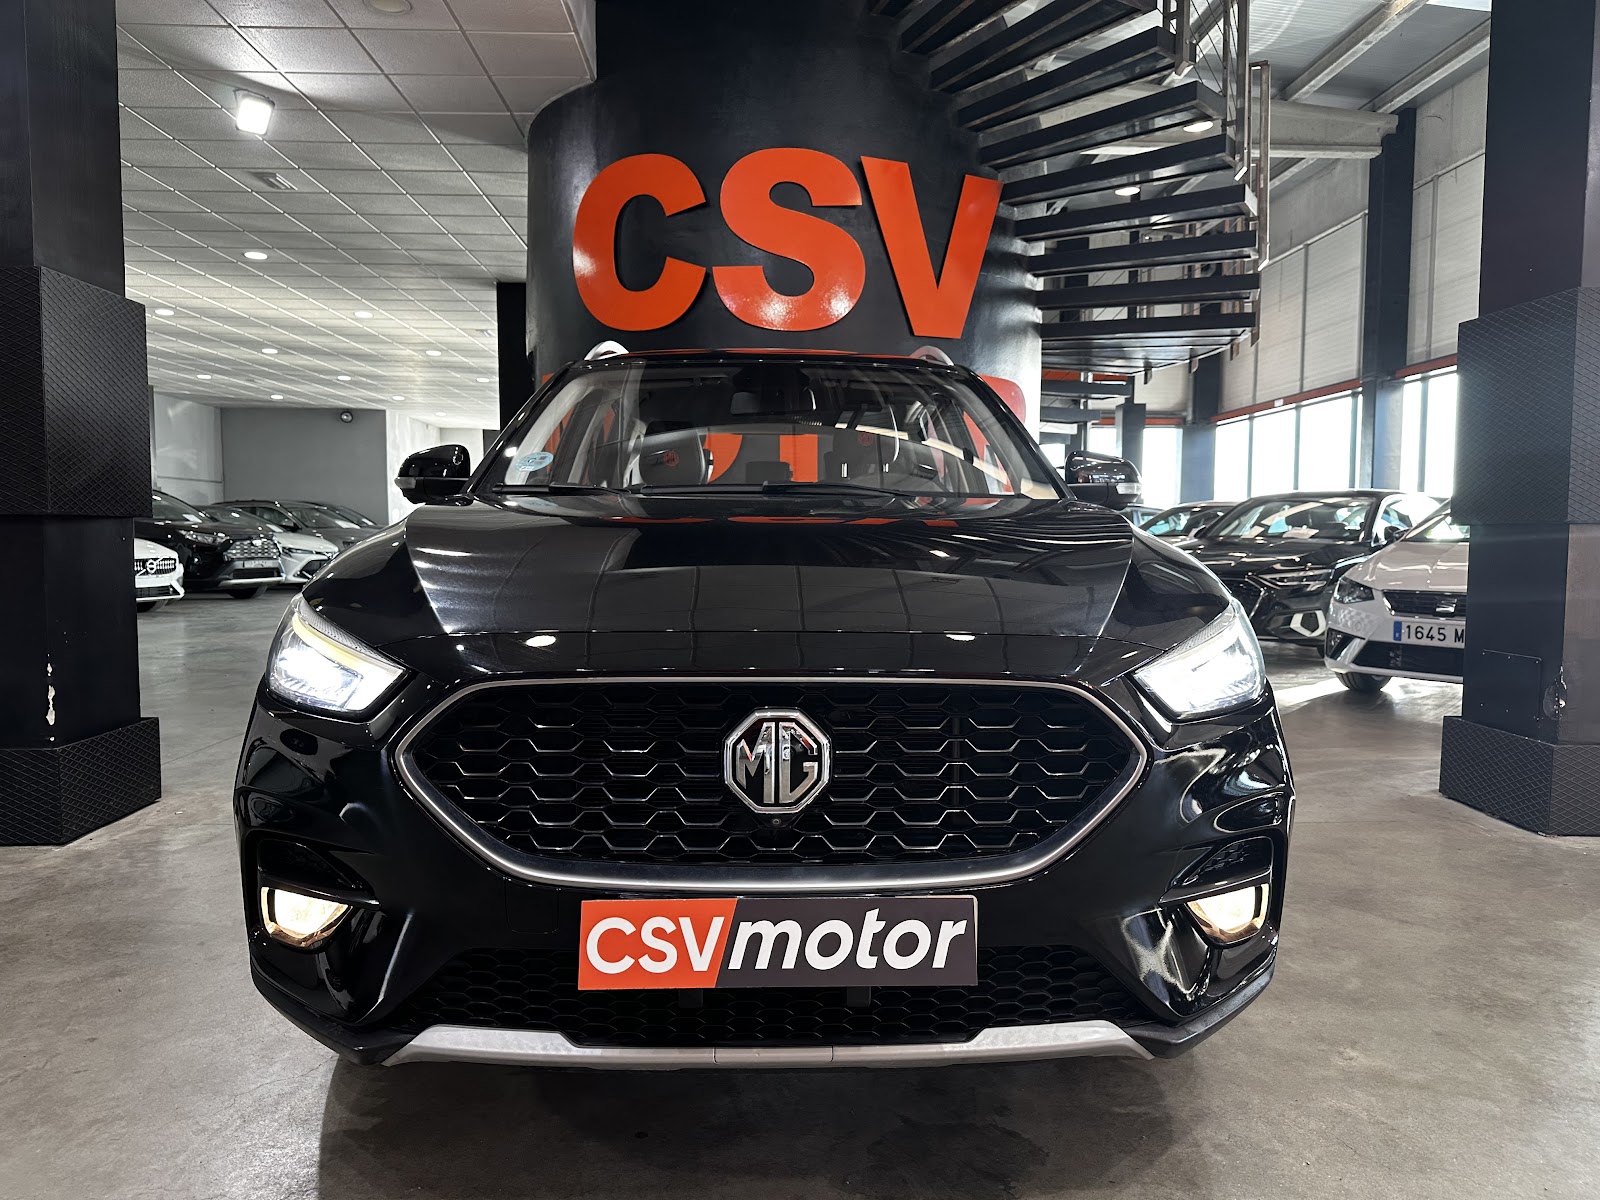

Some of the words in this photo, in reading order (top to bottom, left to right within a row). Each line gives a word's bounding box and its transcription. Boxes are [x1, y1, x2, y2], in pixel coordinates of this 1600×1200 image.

[573, 147, 1004, 339] CSV
[1406, 625, 1446, 641] 1645
[736, 722, 819, 804] MG
